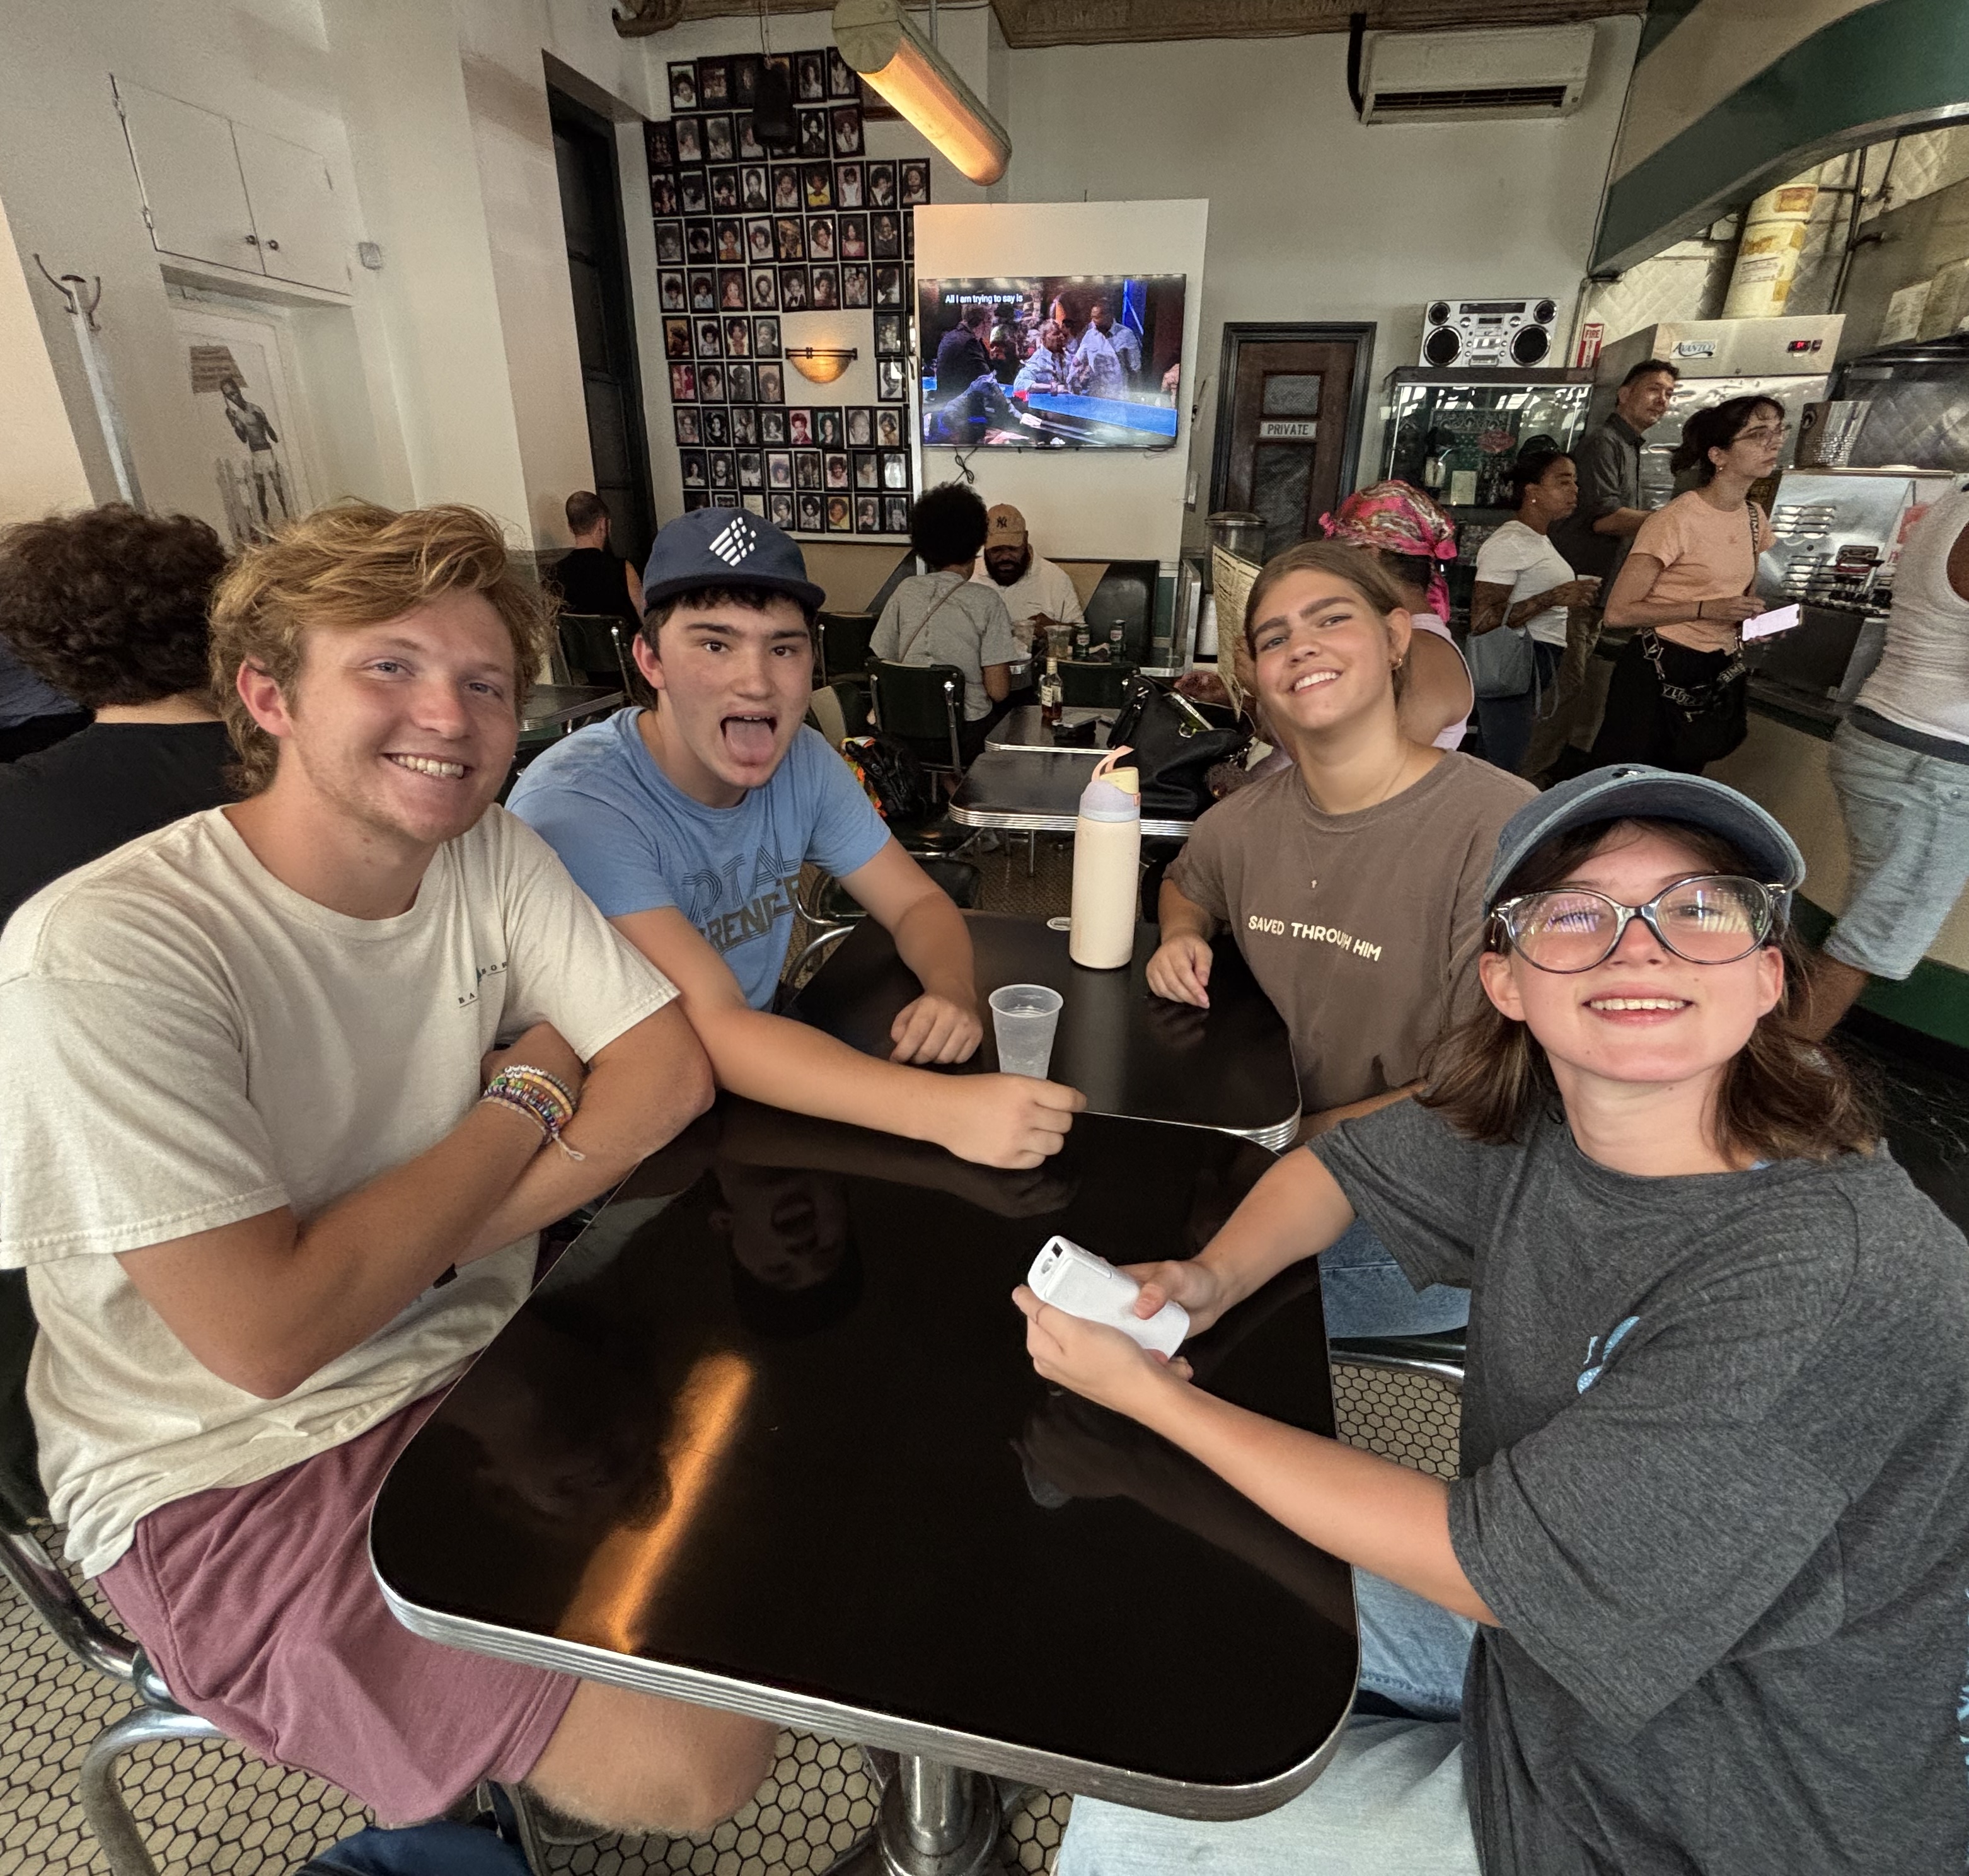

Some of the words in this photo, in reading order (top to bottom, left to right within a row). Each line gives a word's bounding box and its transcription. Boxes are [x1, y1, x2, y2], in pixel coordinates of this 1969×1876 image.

[945, 294, 955, 303] All
[960, 295, 971, 303] am
[973, 294, 993, 304] trying
[993, 294, 1001, 303] to
[1003, 295, 1015, 304] say
[1016, 294, 1023, 302] is
[1585, 330, 1600, 338] FIRE
[1267, 424, 1308, 435] PRIVATE
[1248, 915, 1285, 935] SAVED
[1353, 939, 1382, 961] HIM
